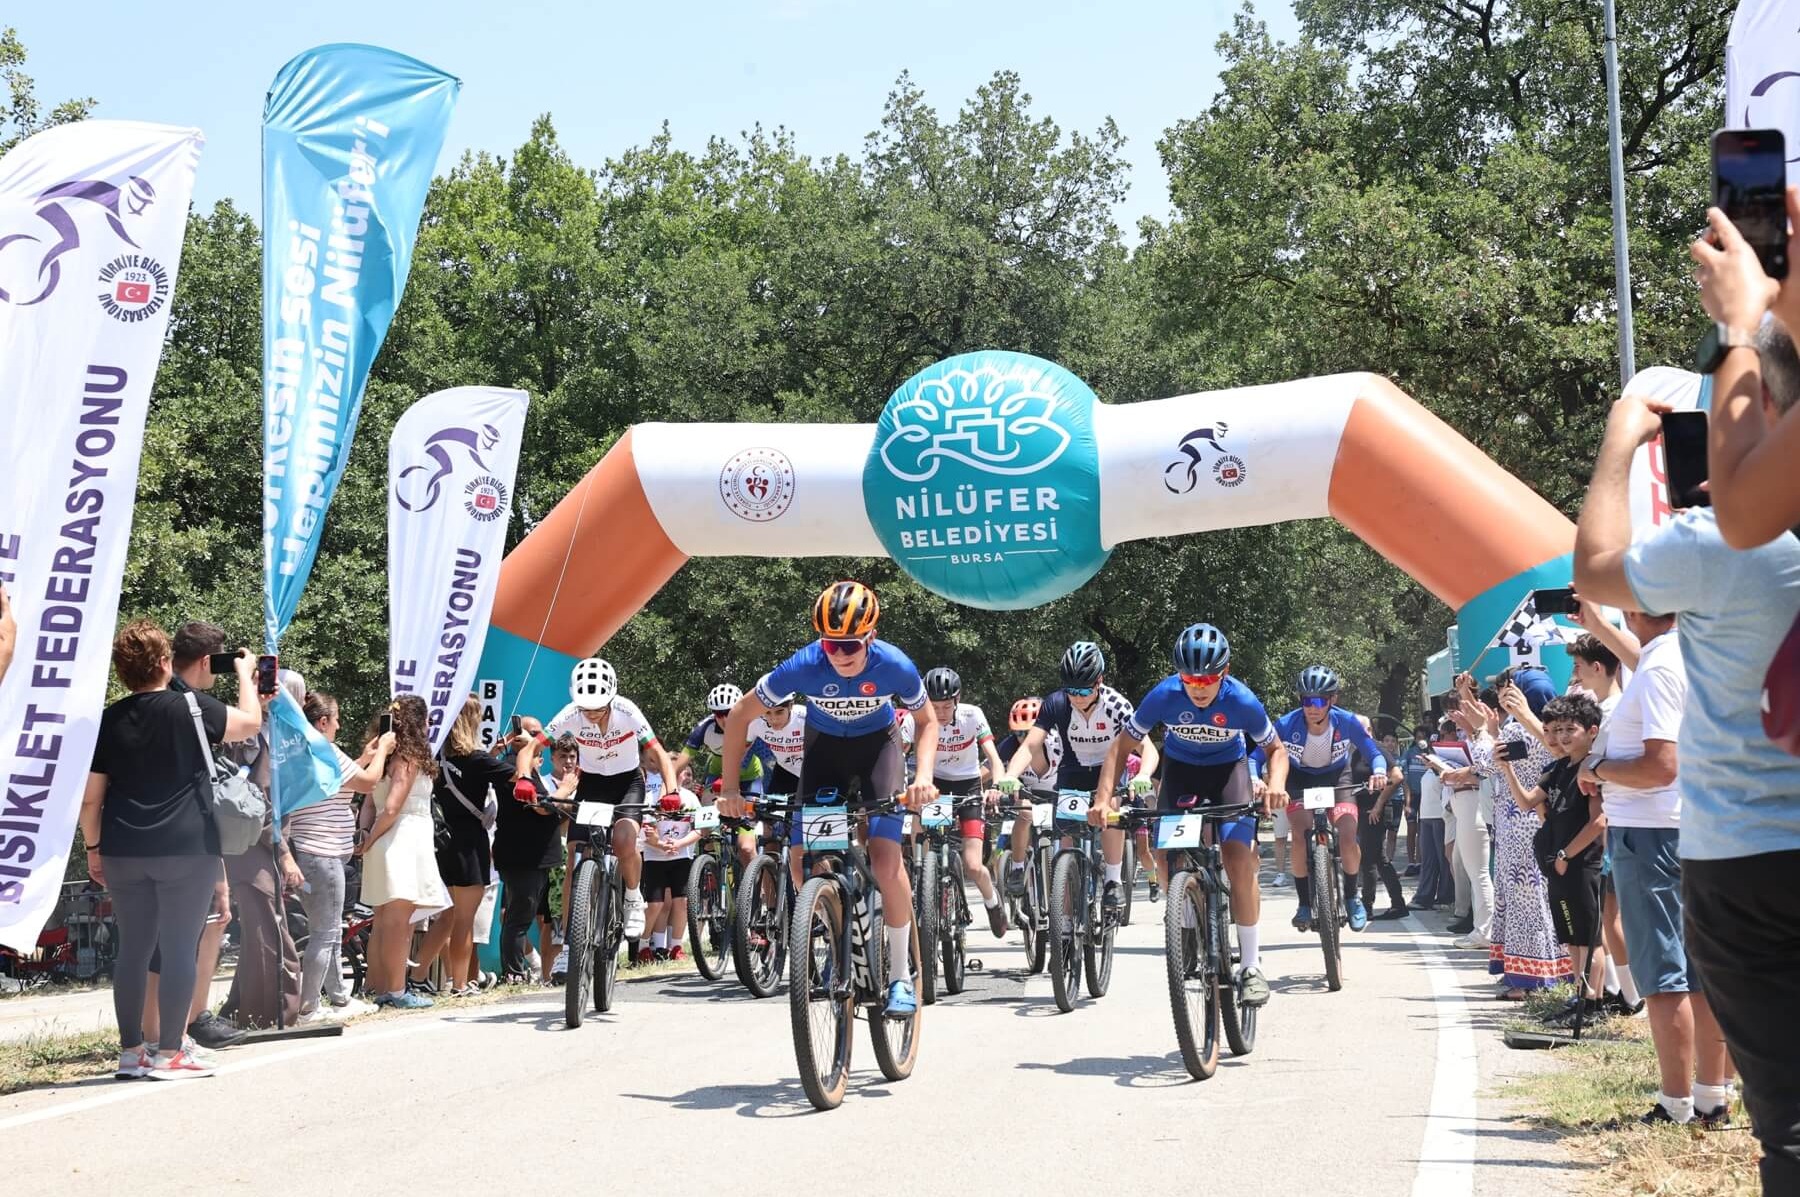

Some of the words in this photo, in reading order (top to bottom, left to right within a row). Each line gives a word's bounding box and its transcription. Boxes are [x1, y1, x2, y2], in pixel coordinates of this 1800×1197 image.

[125, 271, 147, 283] 1923
[280, 219, 321, 326] sesi
[896, 484, 1060, 520] NİLÜFER
[31, 364, 128, 688] FEDERASYONU
[900, 517, 1058, 549] BELEDİYESİ
[951, 552, 1004, 564] BURSA
[426, 548, 482, 744] EDERASYONU
[1171, 726, 1230, 738] KOCAELİ
[932, 804, 942, 817] 3
[1068, 799, 1078, 811] 8
[818, 820, 833, 837] 4
[1173, 824, 1186, 838] 5
